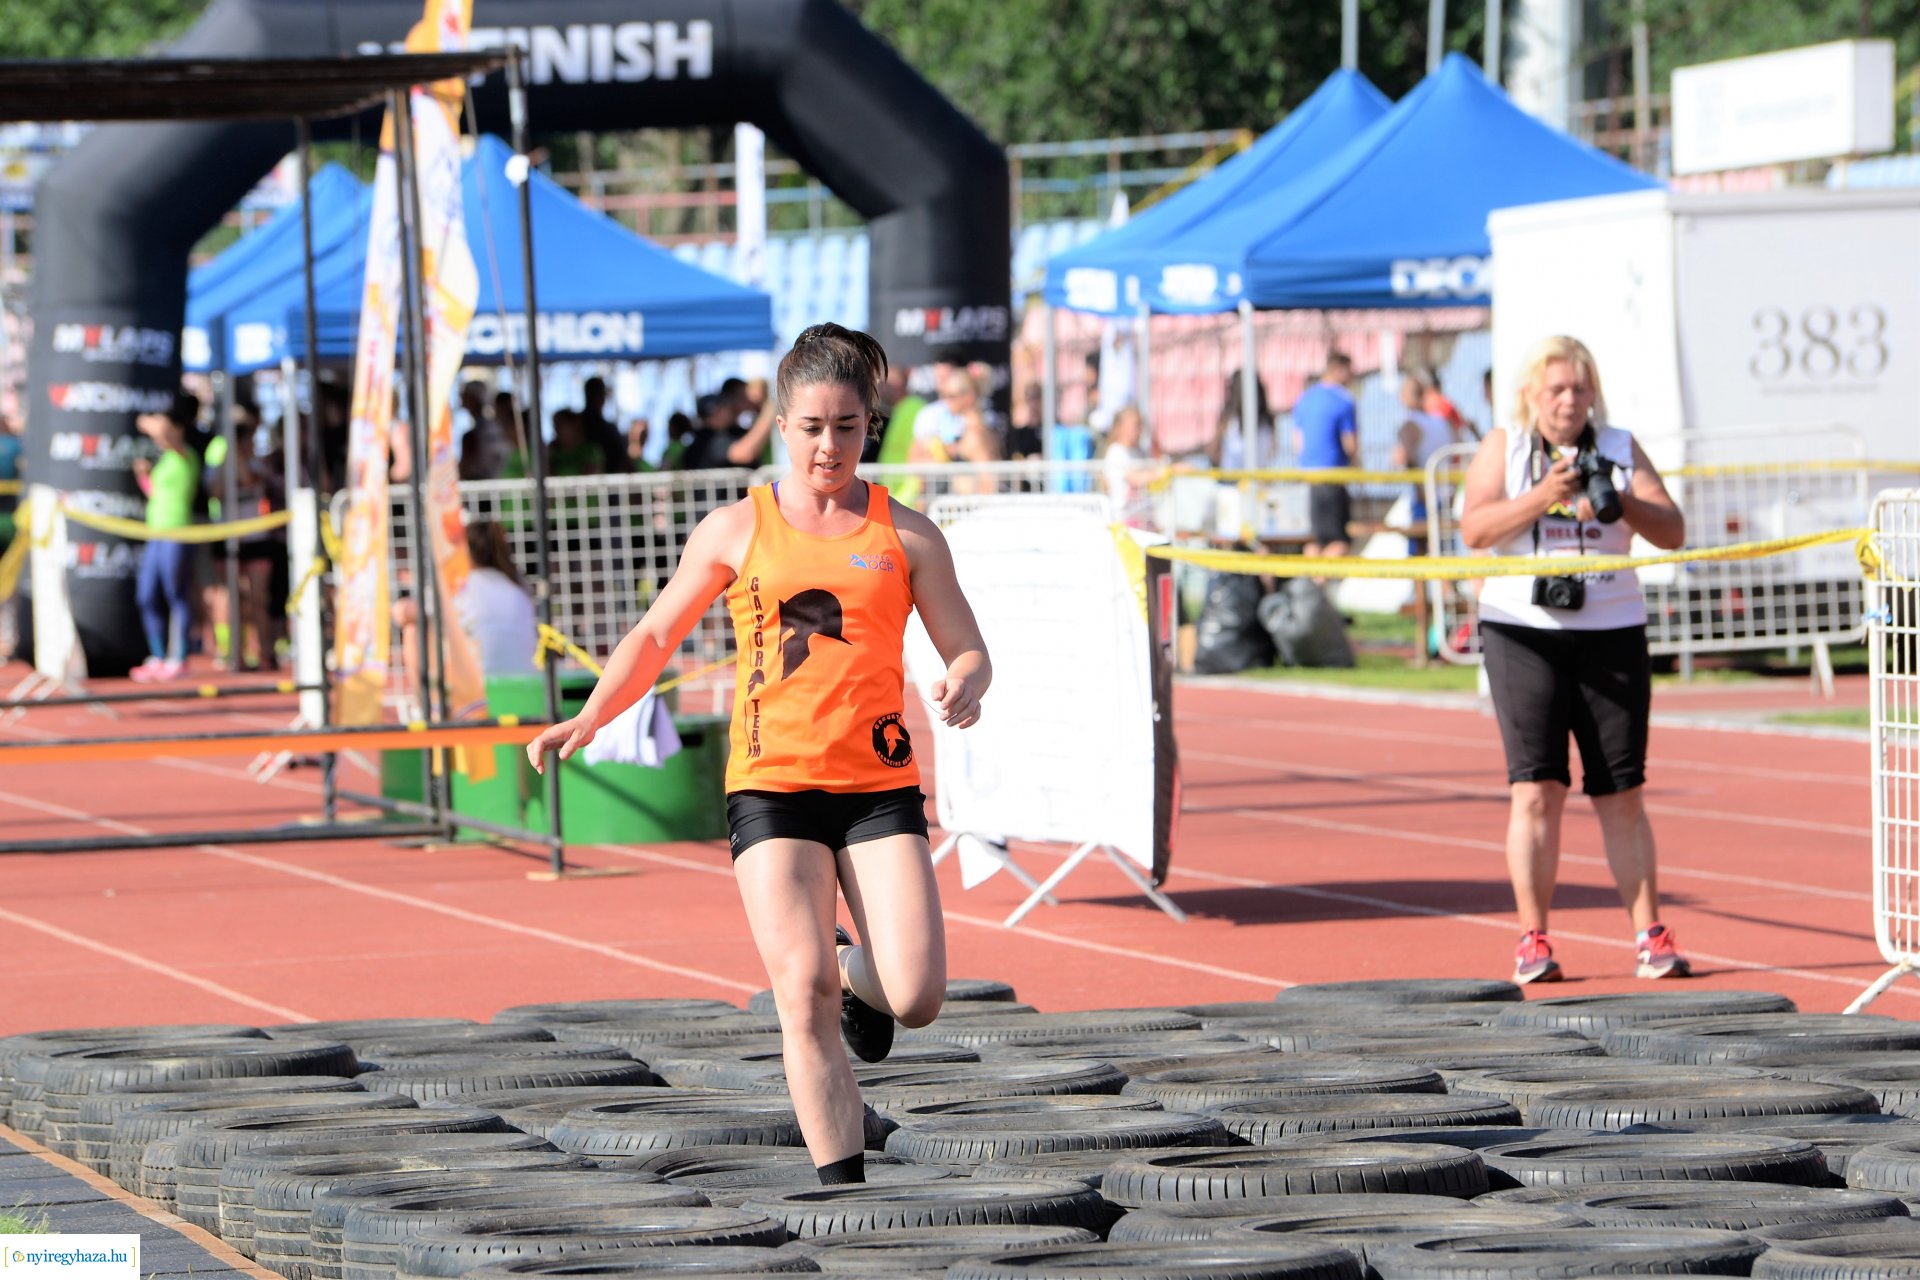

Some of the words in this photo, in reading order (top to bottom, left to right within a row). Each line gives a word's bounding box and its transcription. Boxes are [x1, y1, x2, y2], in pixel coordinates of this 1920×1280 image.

[1749, 303, 1889, 382] 383
[869, 560, 895, 573] OCR
[751, 698, 761, 758] TEAM
